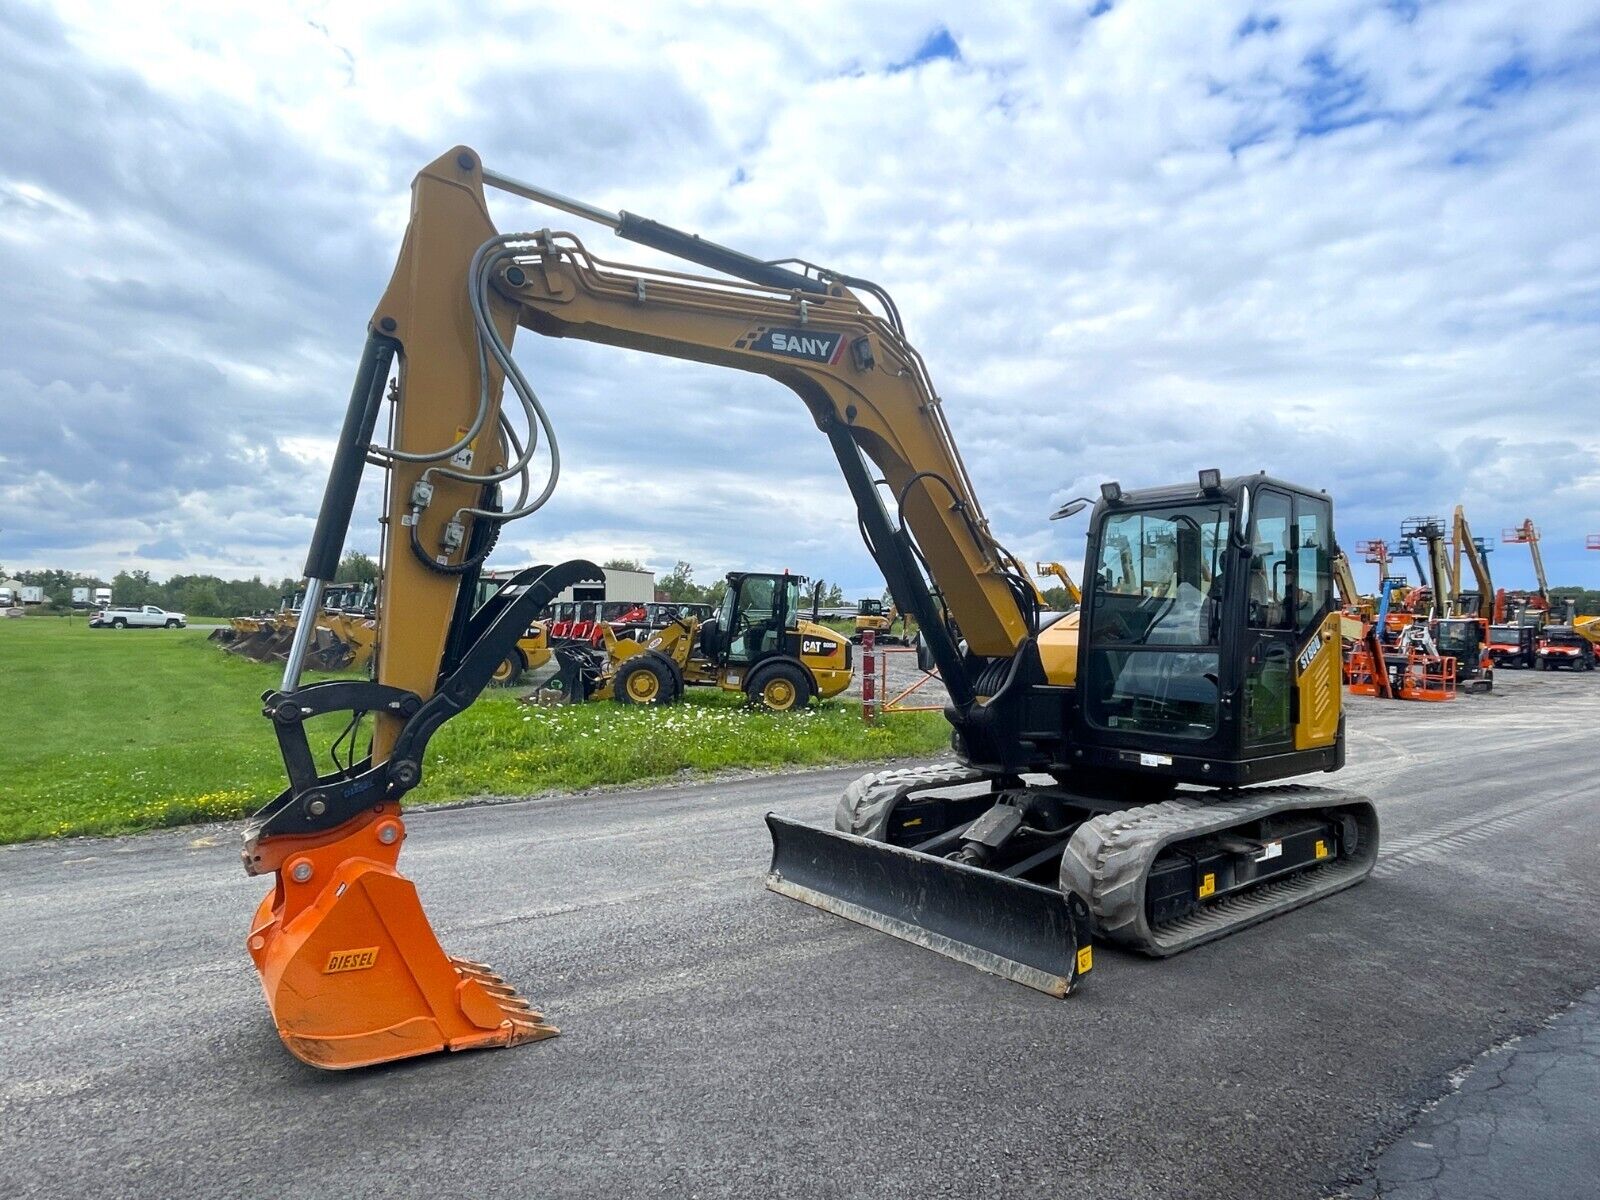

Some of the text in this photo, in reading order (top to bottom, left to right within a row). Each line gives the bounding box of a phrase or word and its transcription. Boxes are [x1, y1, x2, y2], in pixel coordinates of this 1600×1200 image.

[772, 333, 830, 356] SANY
[803, 640, 821, 652] CAT
[328, 952, 373, 970] DIESEL
